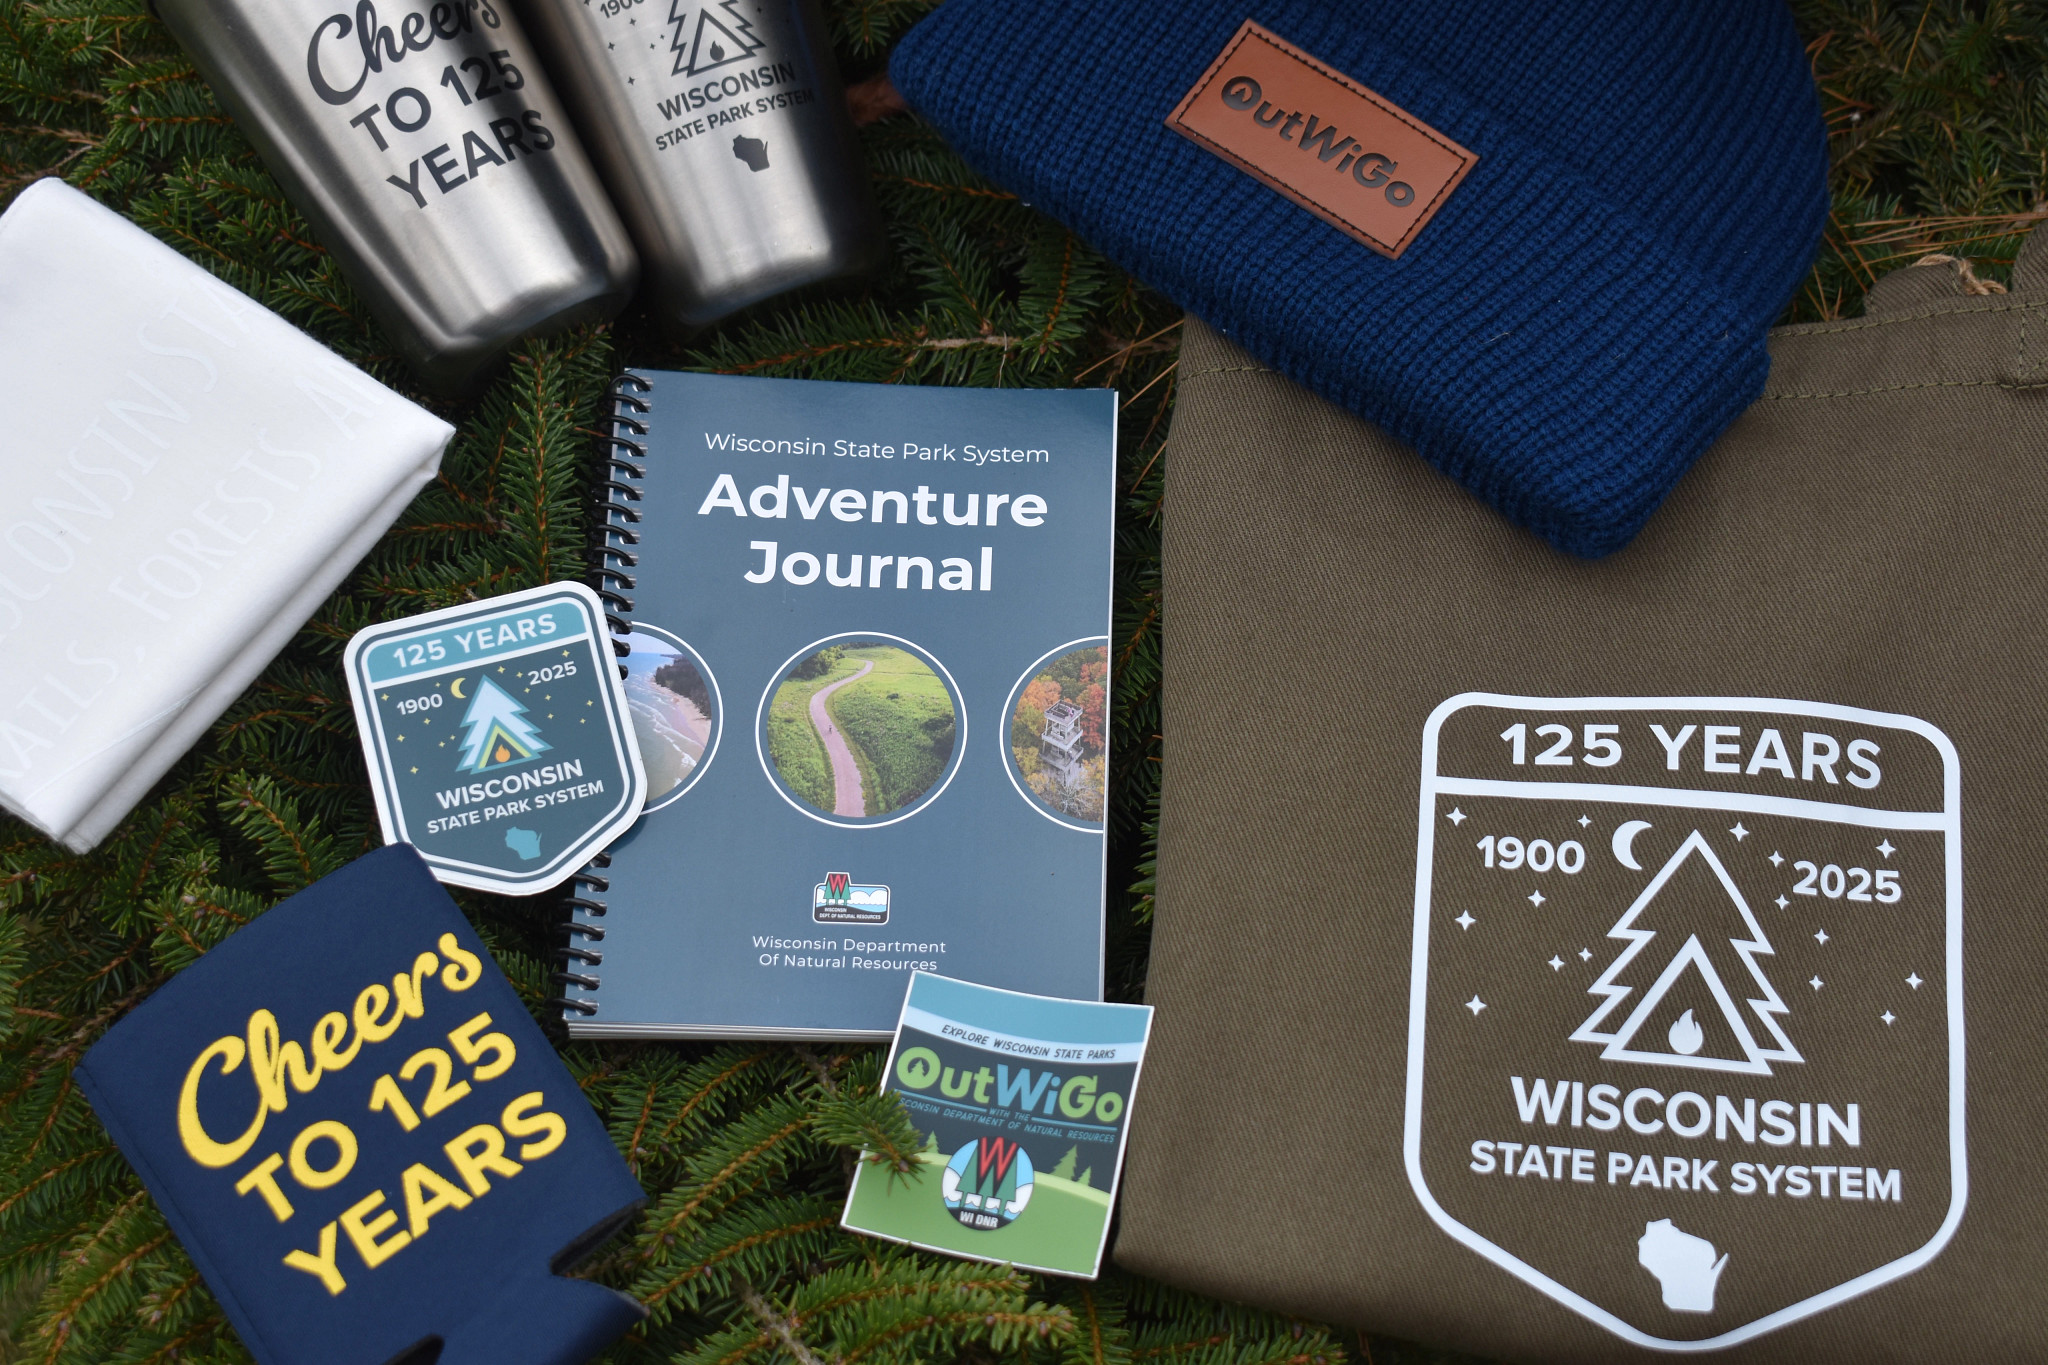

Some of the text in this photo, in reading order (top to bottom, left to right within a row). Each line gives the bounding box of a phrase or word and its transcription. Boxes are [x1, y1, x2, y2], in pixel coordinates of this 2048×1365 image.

[600, 0, 645, 19] 190
[350, 49, 525, 153] TO 125
[655, 88, 816, 151] STATE PARK SYSTEM
[657, 62, 797, 122] WISCONSIN
[386, 110, 556, 210] YEARS
[1221, 76, 1415, 208] OutWiGo
[704, 432, 1050, 467] Wisconsin State Park System
[108, 427, 323, 621] FORESTS
[697, 473, 1049, 528] Adventure
[743, 540, 994, 592] Journal
[393, 613, 558, 669] 125 YEARS
[527, 660, 578, 686] 2025
[396, 693, 444, 716] 1900
[436, 758, 584, 810] WISCONSIN
[1500, 723, 1882, 790] 125 YEARS
[427, 780, 605, 835] STATE PARK SYSTEM
[1476, 835, 1586, 874] 1900
[1792, 860, 1902, 903] 2025
[752, 935, 947, 954] Wisconsin Department
[759, 953, 938, 971] Of Natural Resources
[177, 933, 483, 1169] Cheers
[941, 1024, 1117, 1060] EXPLORE WISCONSIN STATE PARKS
[896, 1046, 1124, 1123] OutWiGo
[1510, 1076, 1861, 1147] WISCONSIN
[235, 1011, 517, 1224] TO 125
[899, 1097, 1116, 1144] SCONSIN DEPARTMENT OF NATURAL RESOURCES
[989, 1107, 1031, 1122] WITH THE
[283, 1091, 568, 1296] YEARS
[1469, 1140, 1902, 1202] STATE PARK SYSTEM
[959, 1210, 999, 1229] WI DNR
